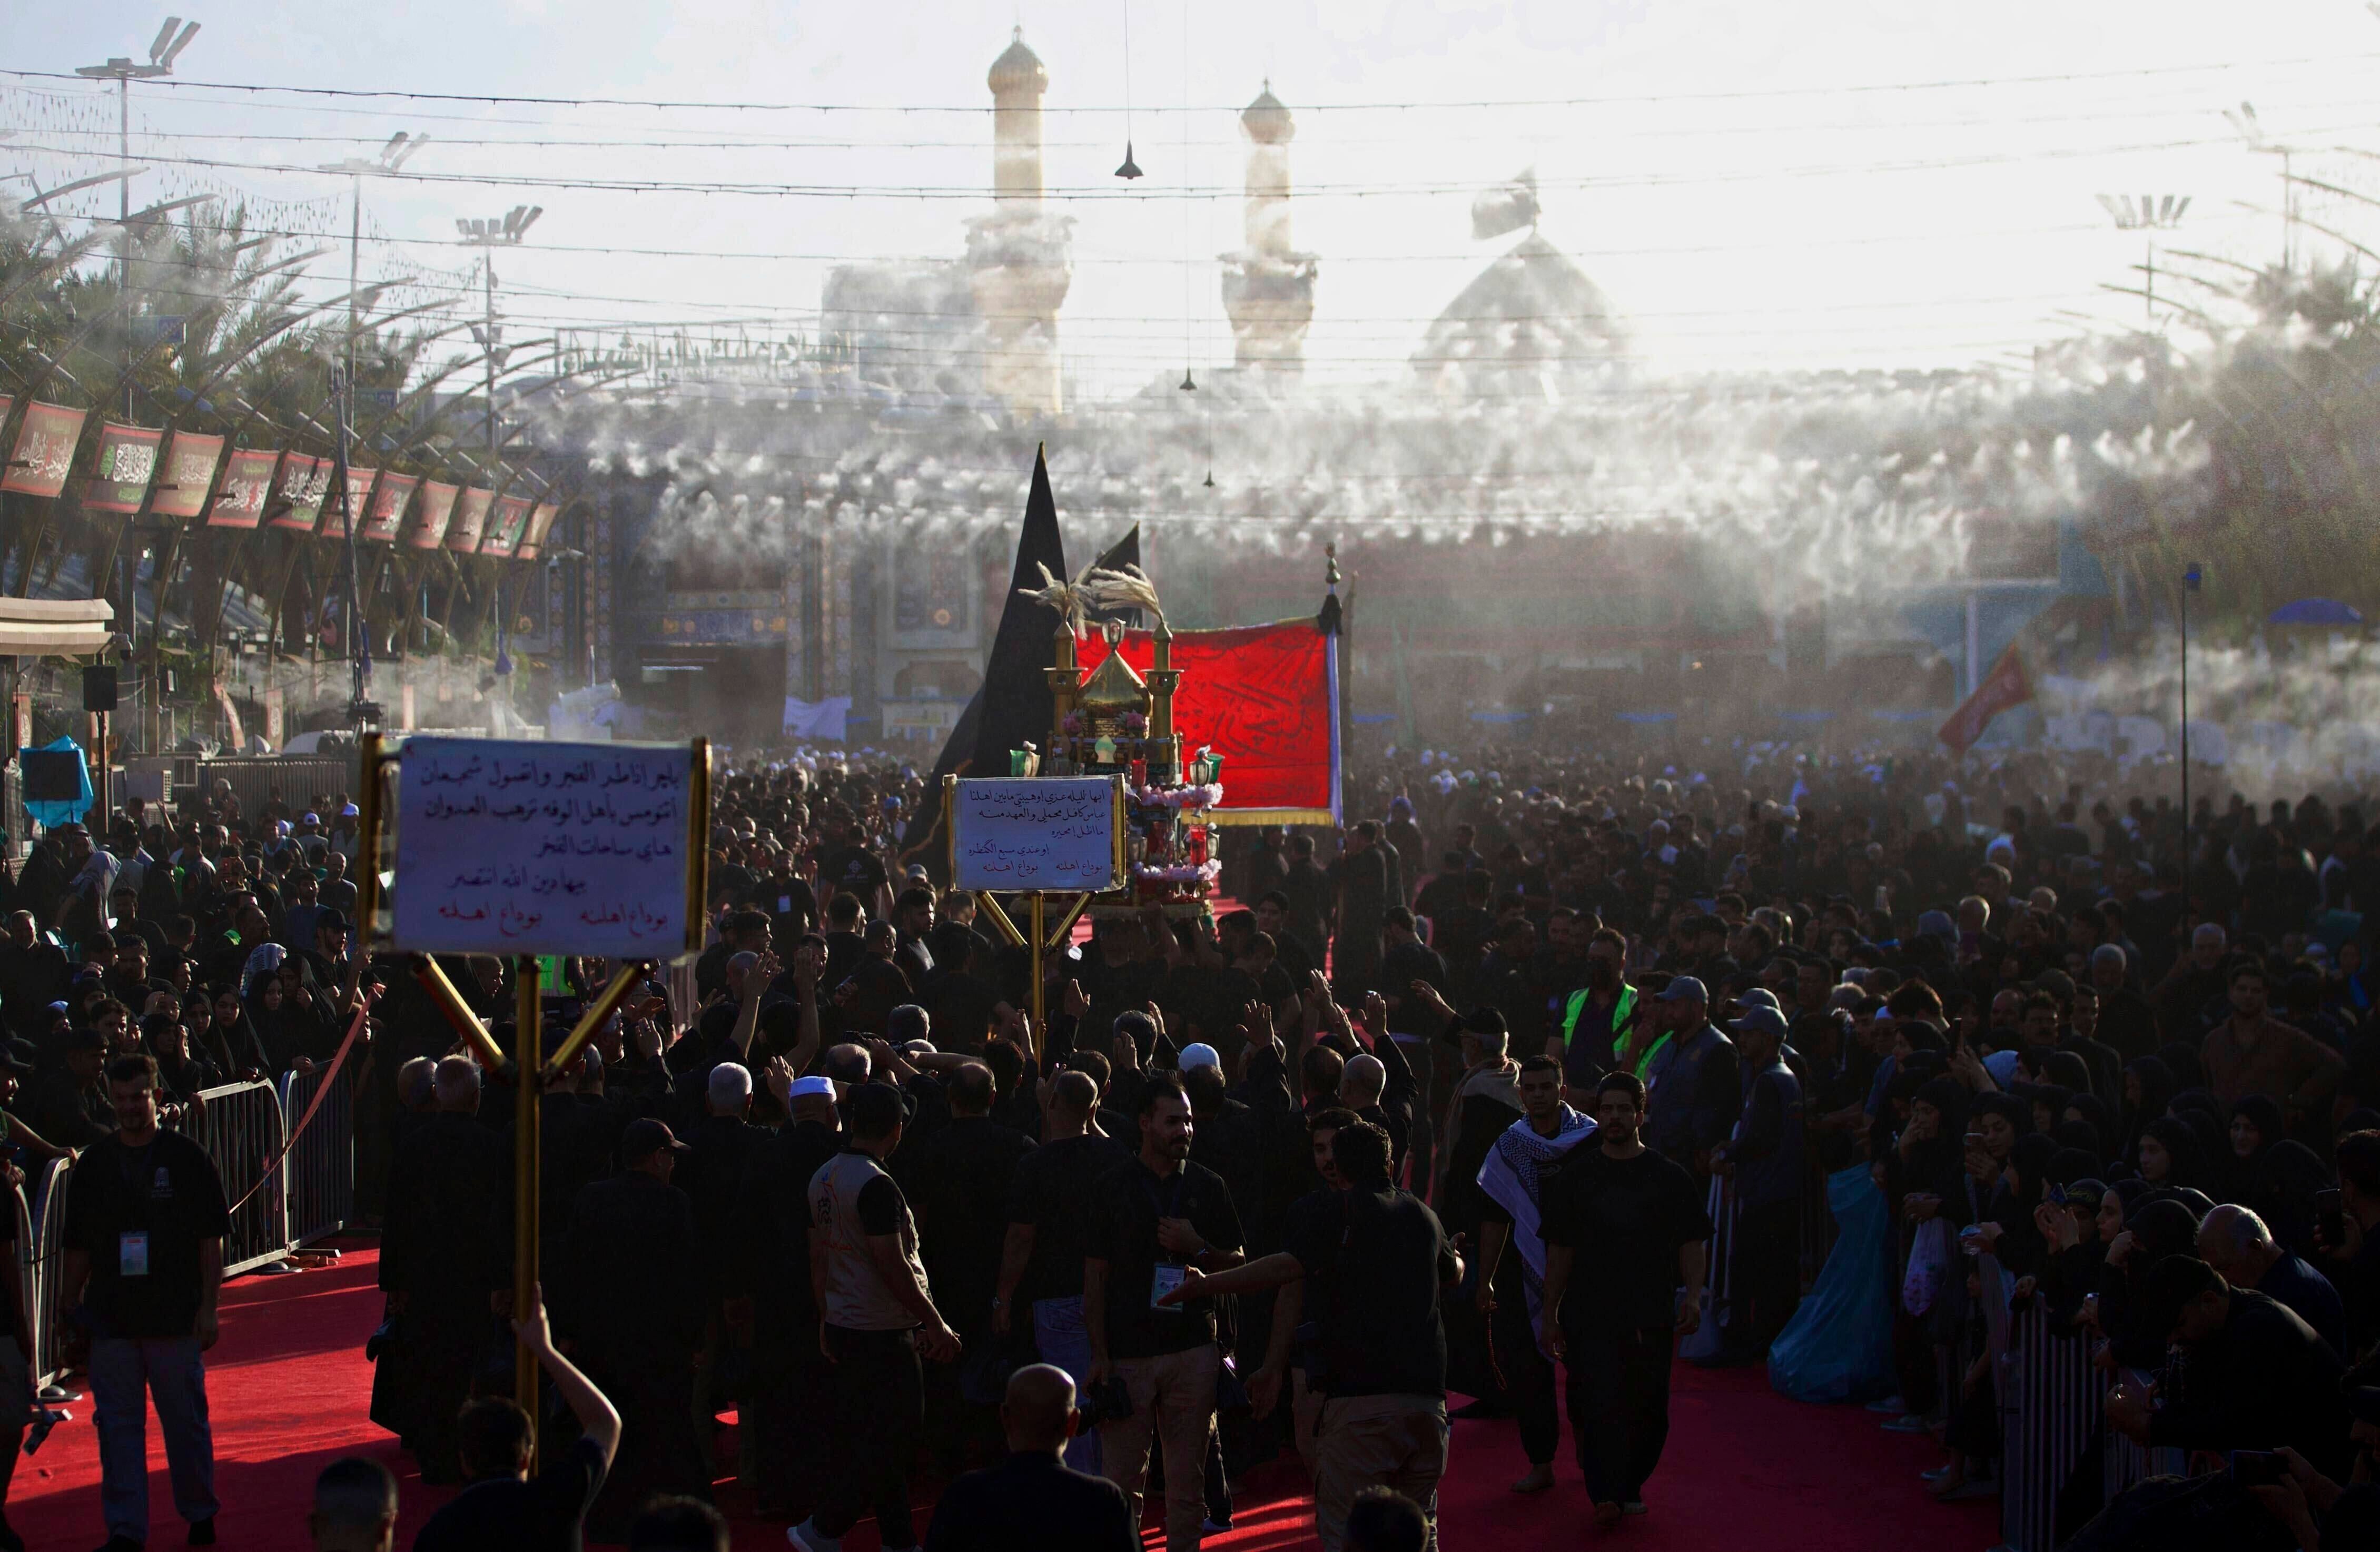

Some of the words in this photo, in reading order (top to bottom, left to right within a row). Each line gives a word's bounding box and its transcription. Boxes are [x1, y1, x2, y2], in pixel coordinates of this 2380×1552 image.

[1062, 804, 1088, 822] كافل
[1083, 807, 1106, 822] عباس
[501, 863, 528, 889] الله
[1017, 859, 1039, 878] بوداع
[1081, 859, 1103, 877] بوداع
